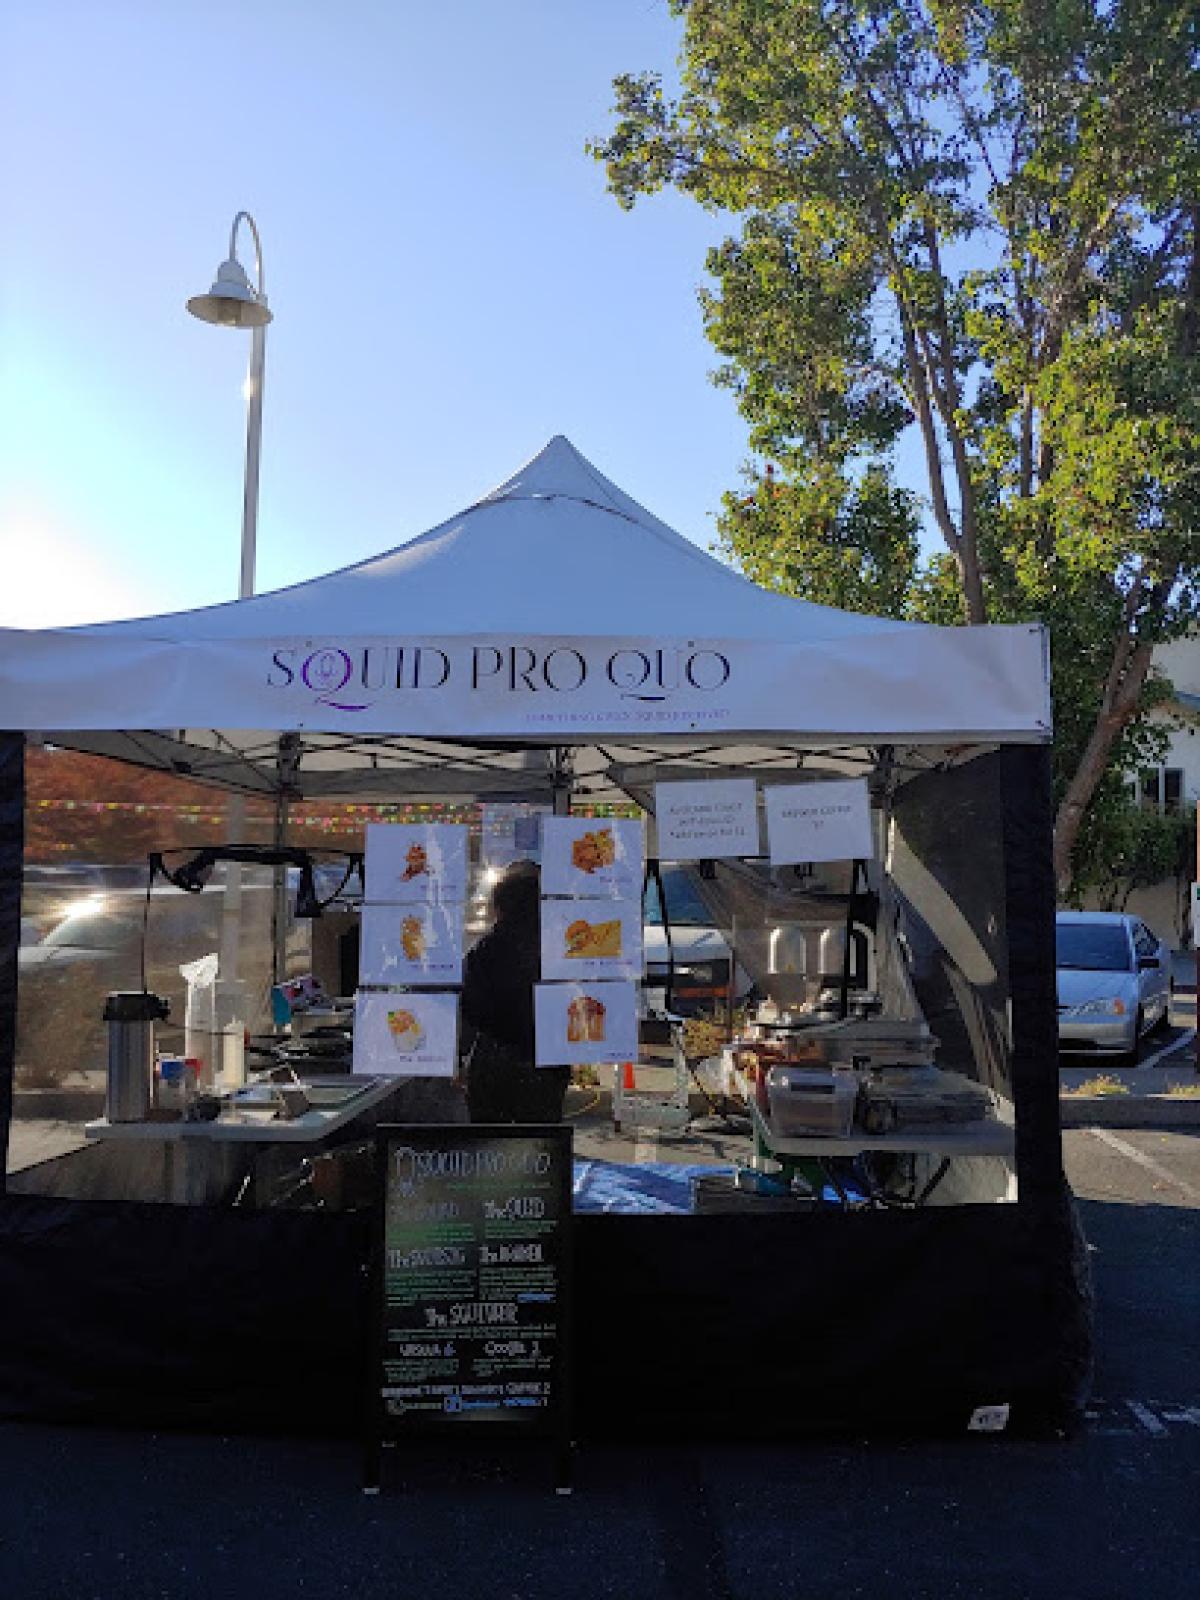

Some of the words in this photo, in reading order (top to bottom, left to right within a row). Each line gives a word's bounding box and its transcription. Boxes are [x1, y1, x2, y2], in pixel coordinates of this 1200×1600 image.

[267, 646, 450, 711] SQUID
[471, 646, 587, 692] PRO
[606, 648, 731, 701] QUO
